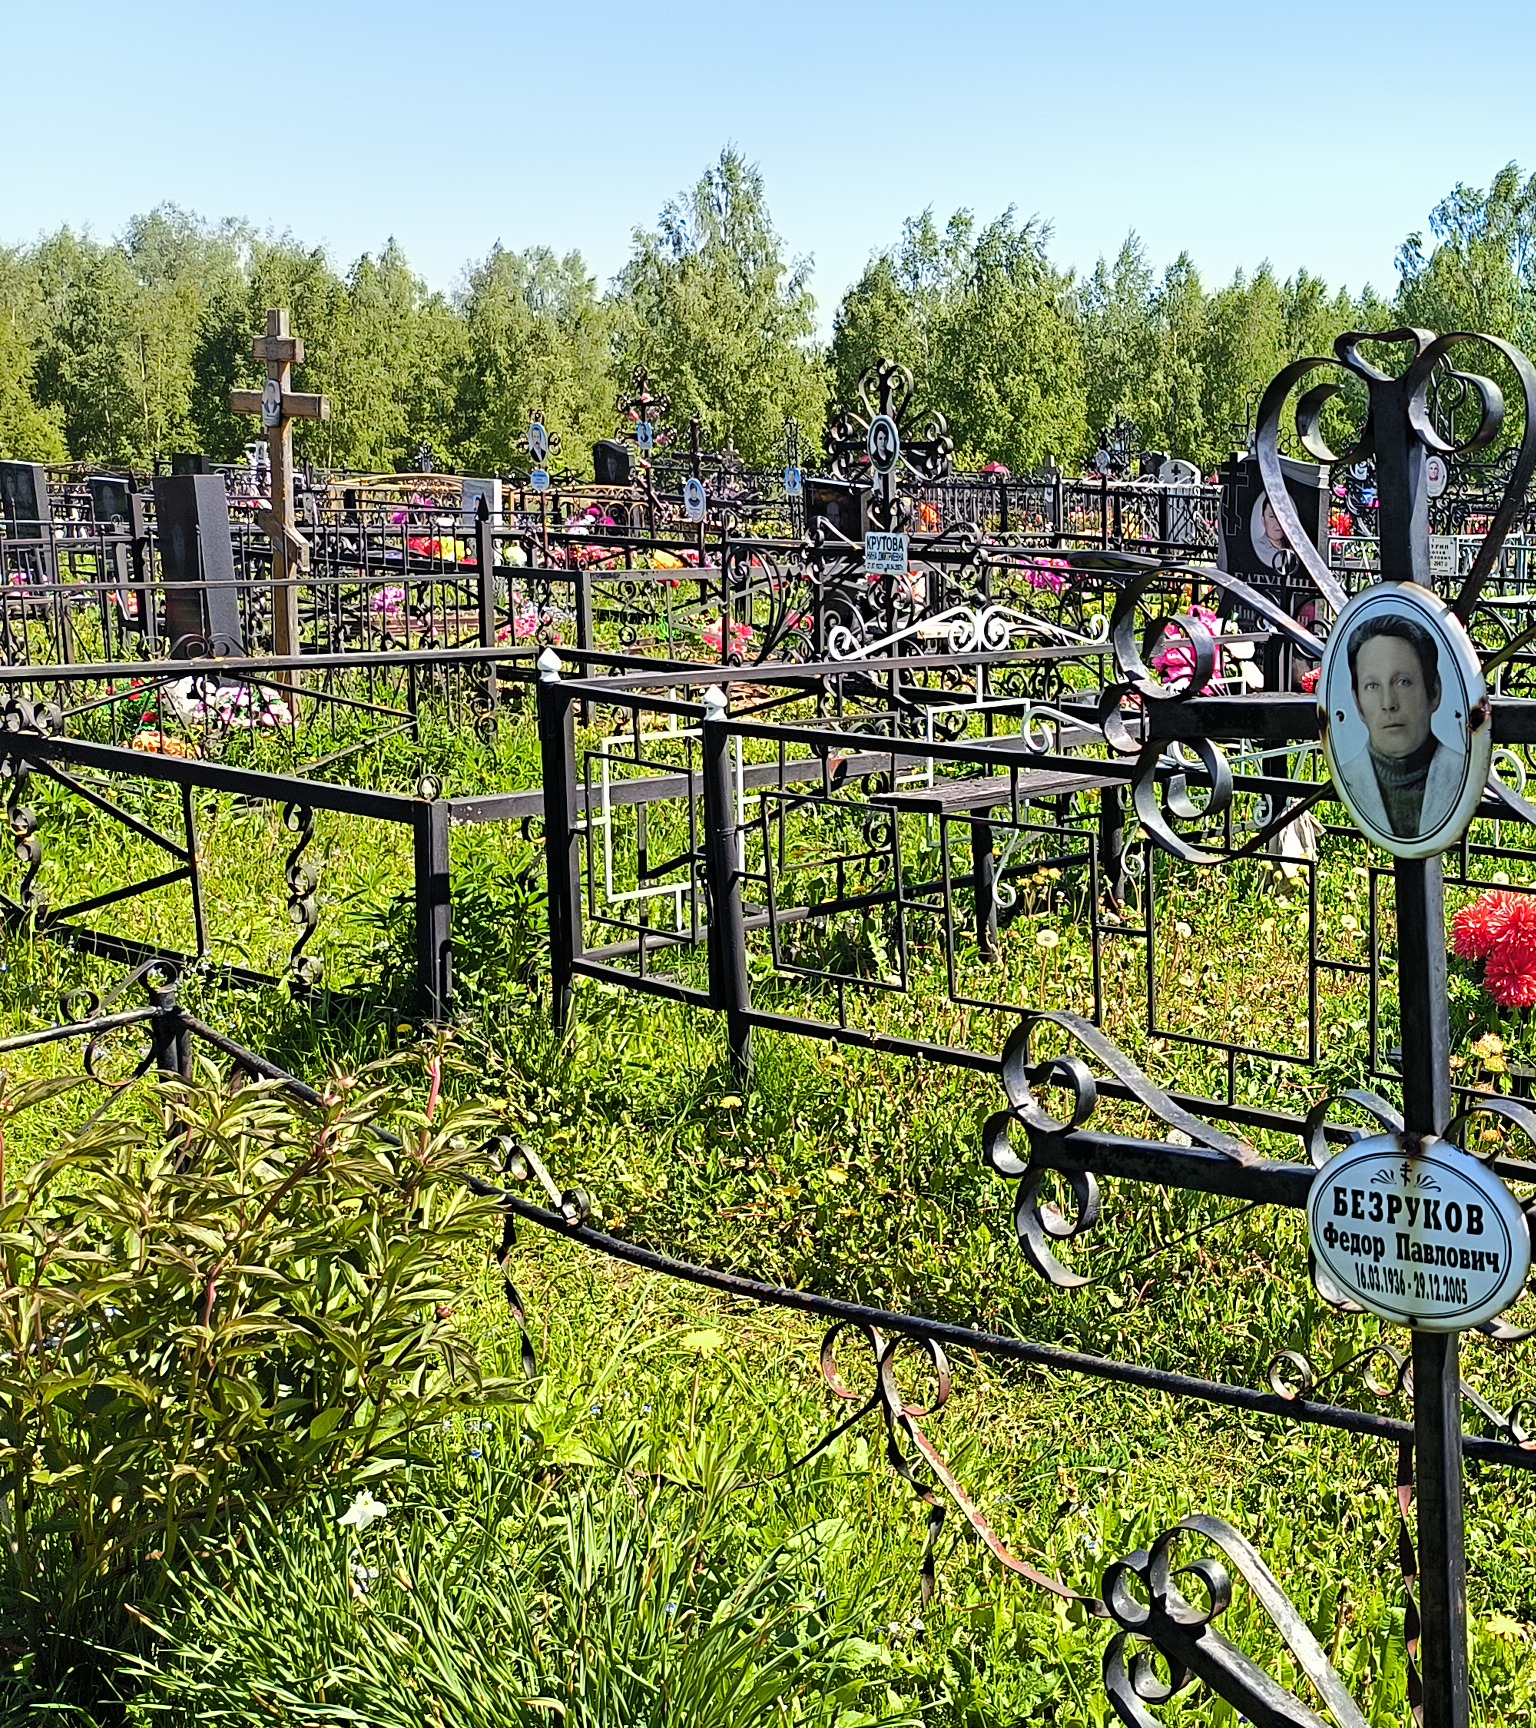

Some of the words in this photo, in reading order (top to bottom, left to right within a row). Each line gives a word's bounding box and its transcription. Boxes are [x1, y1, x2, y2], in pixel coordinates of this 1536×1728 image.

[866, 535, 904, 552] КРУТОВА
[1333, 1186, 1484, 1236] БЕЗРУКОВ
[1323, 1222, 1386, 1263] Федор
[1396, 1232, 1500, 1274] Павлович
[1413, 1270, 1468, 1305] 29.12.2005
